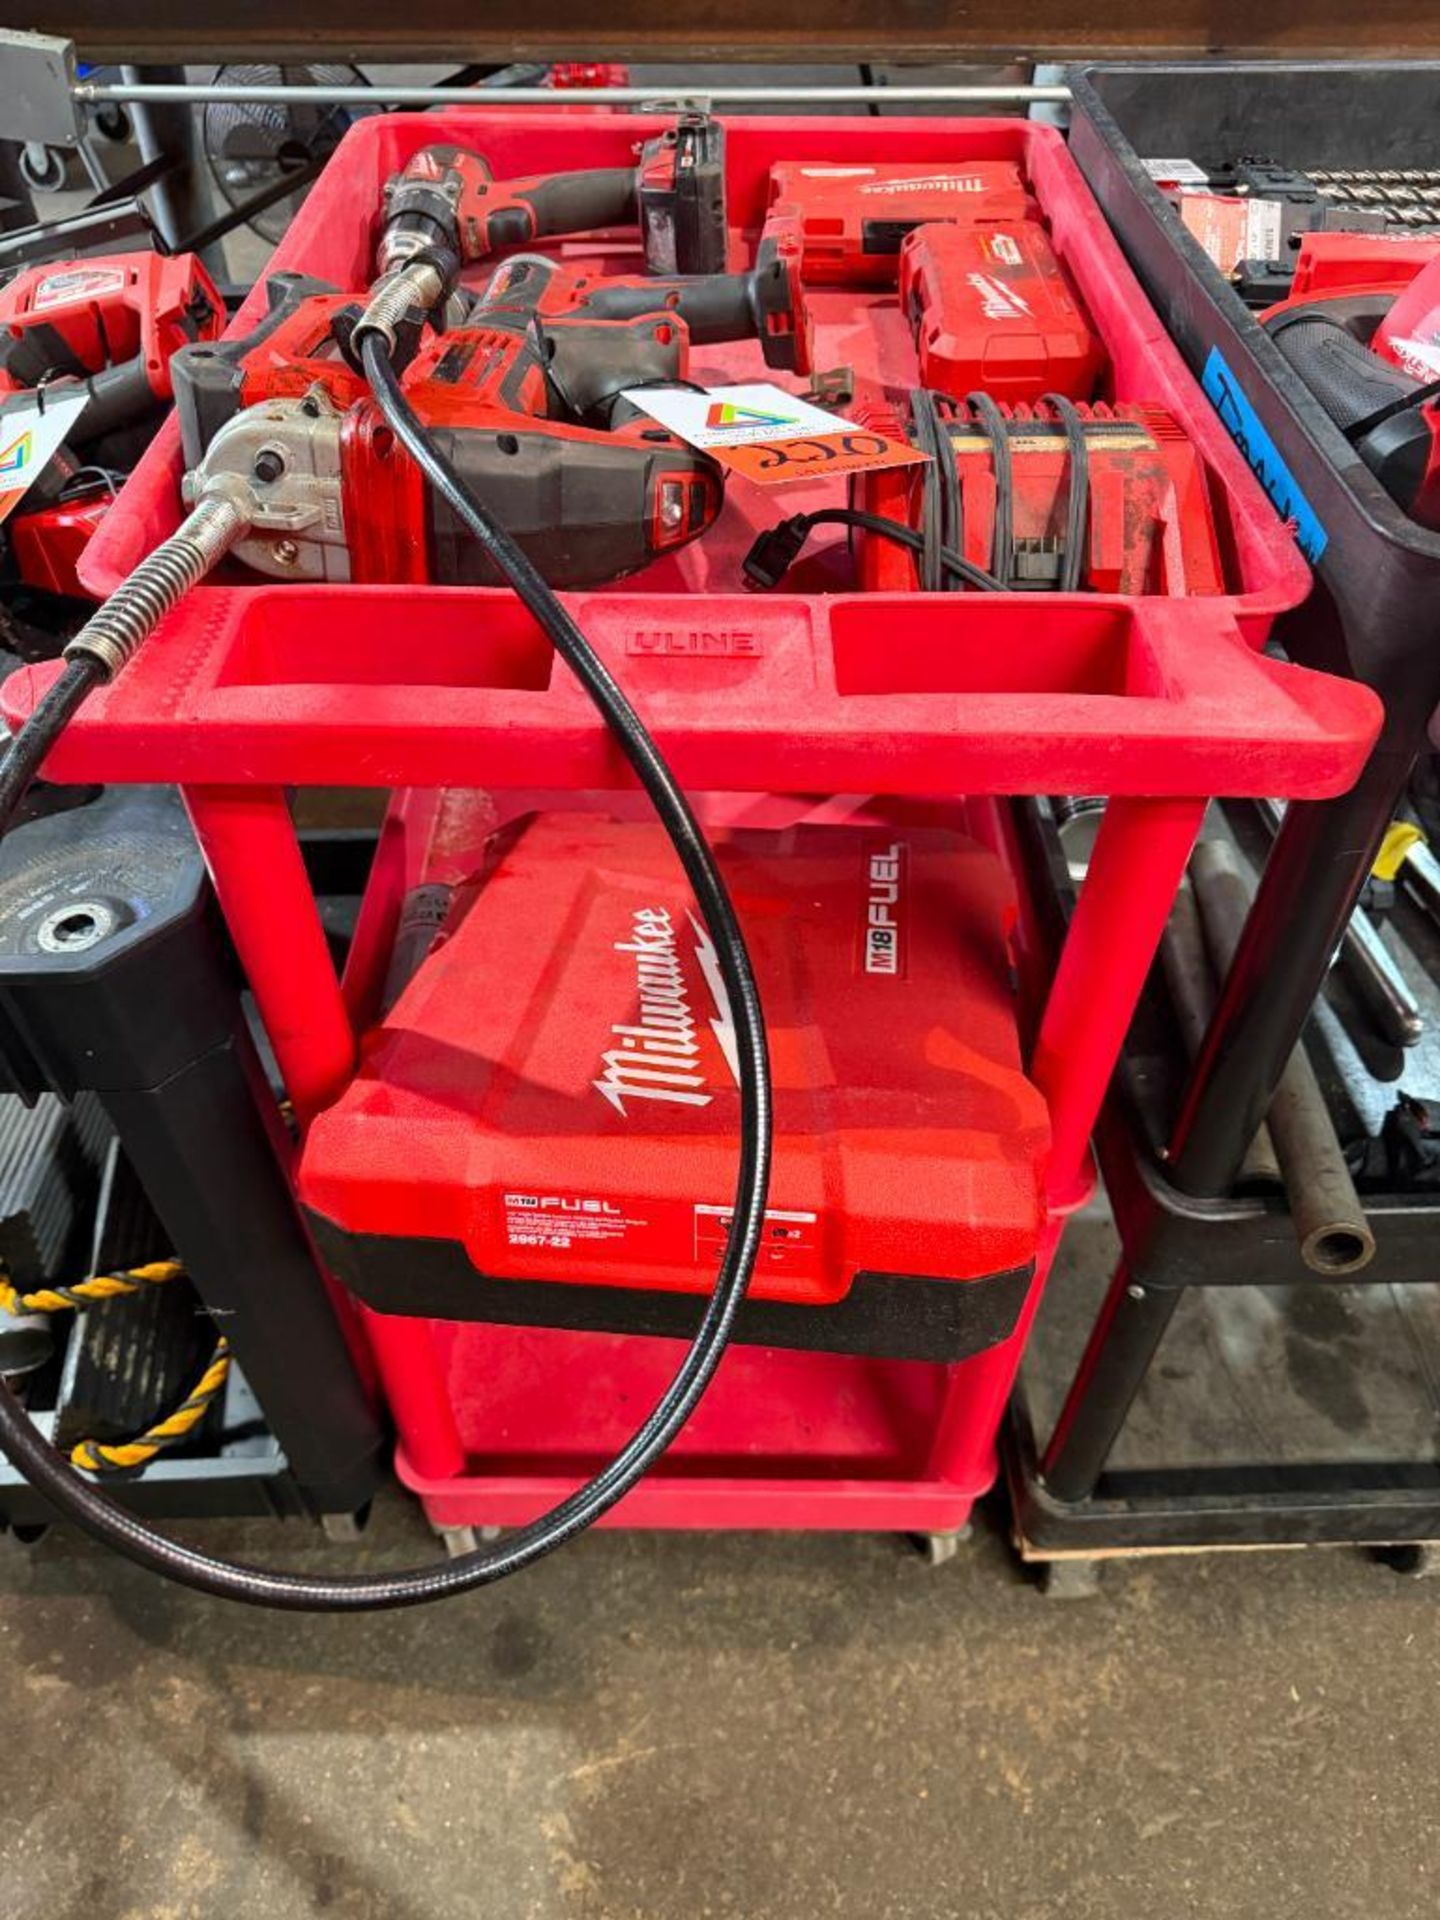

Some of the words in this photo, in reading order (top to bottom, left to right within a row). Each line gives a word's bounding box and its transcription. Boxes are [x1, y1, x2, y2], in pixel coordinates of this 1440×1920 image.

[728, 435, 889, 468] 220
[635, 632, 754, 651] ULINE
[868, 843, 901, 927] FUEL
[869, 930, 895, 971] M18
[592, 906, 713, 1117] Milwaukee
[541, 1197, 621, 1214] FUEL
